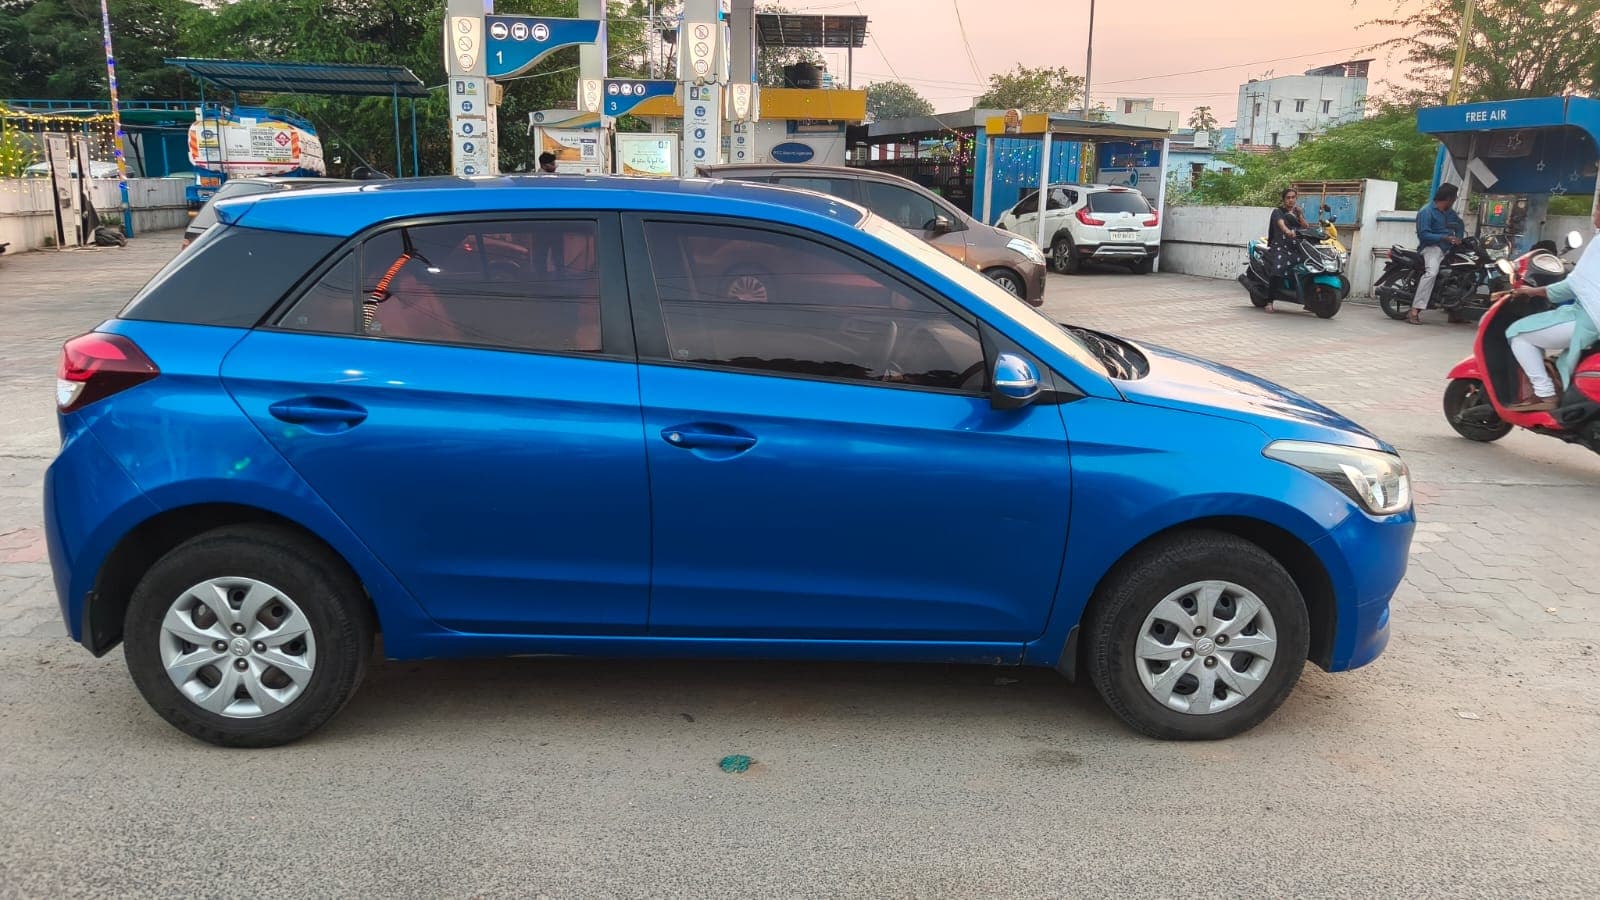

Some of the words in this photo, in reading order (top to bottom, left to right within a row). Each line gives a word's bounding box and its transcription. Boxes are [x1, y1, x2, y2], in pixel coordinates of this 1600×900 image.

[496, 50, 503, 65] 1
[610, 101, 617, 111] 3
[1465, 111, 1487, 122] FREE
[1490, 109, 1507, 121] AIR
